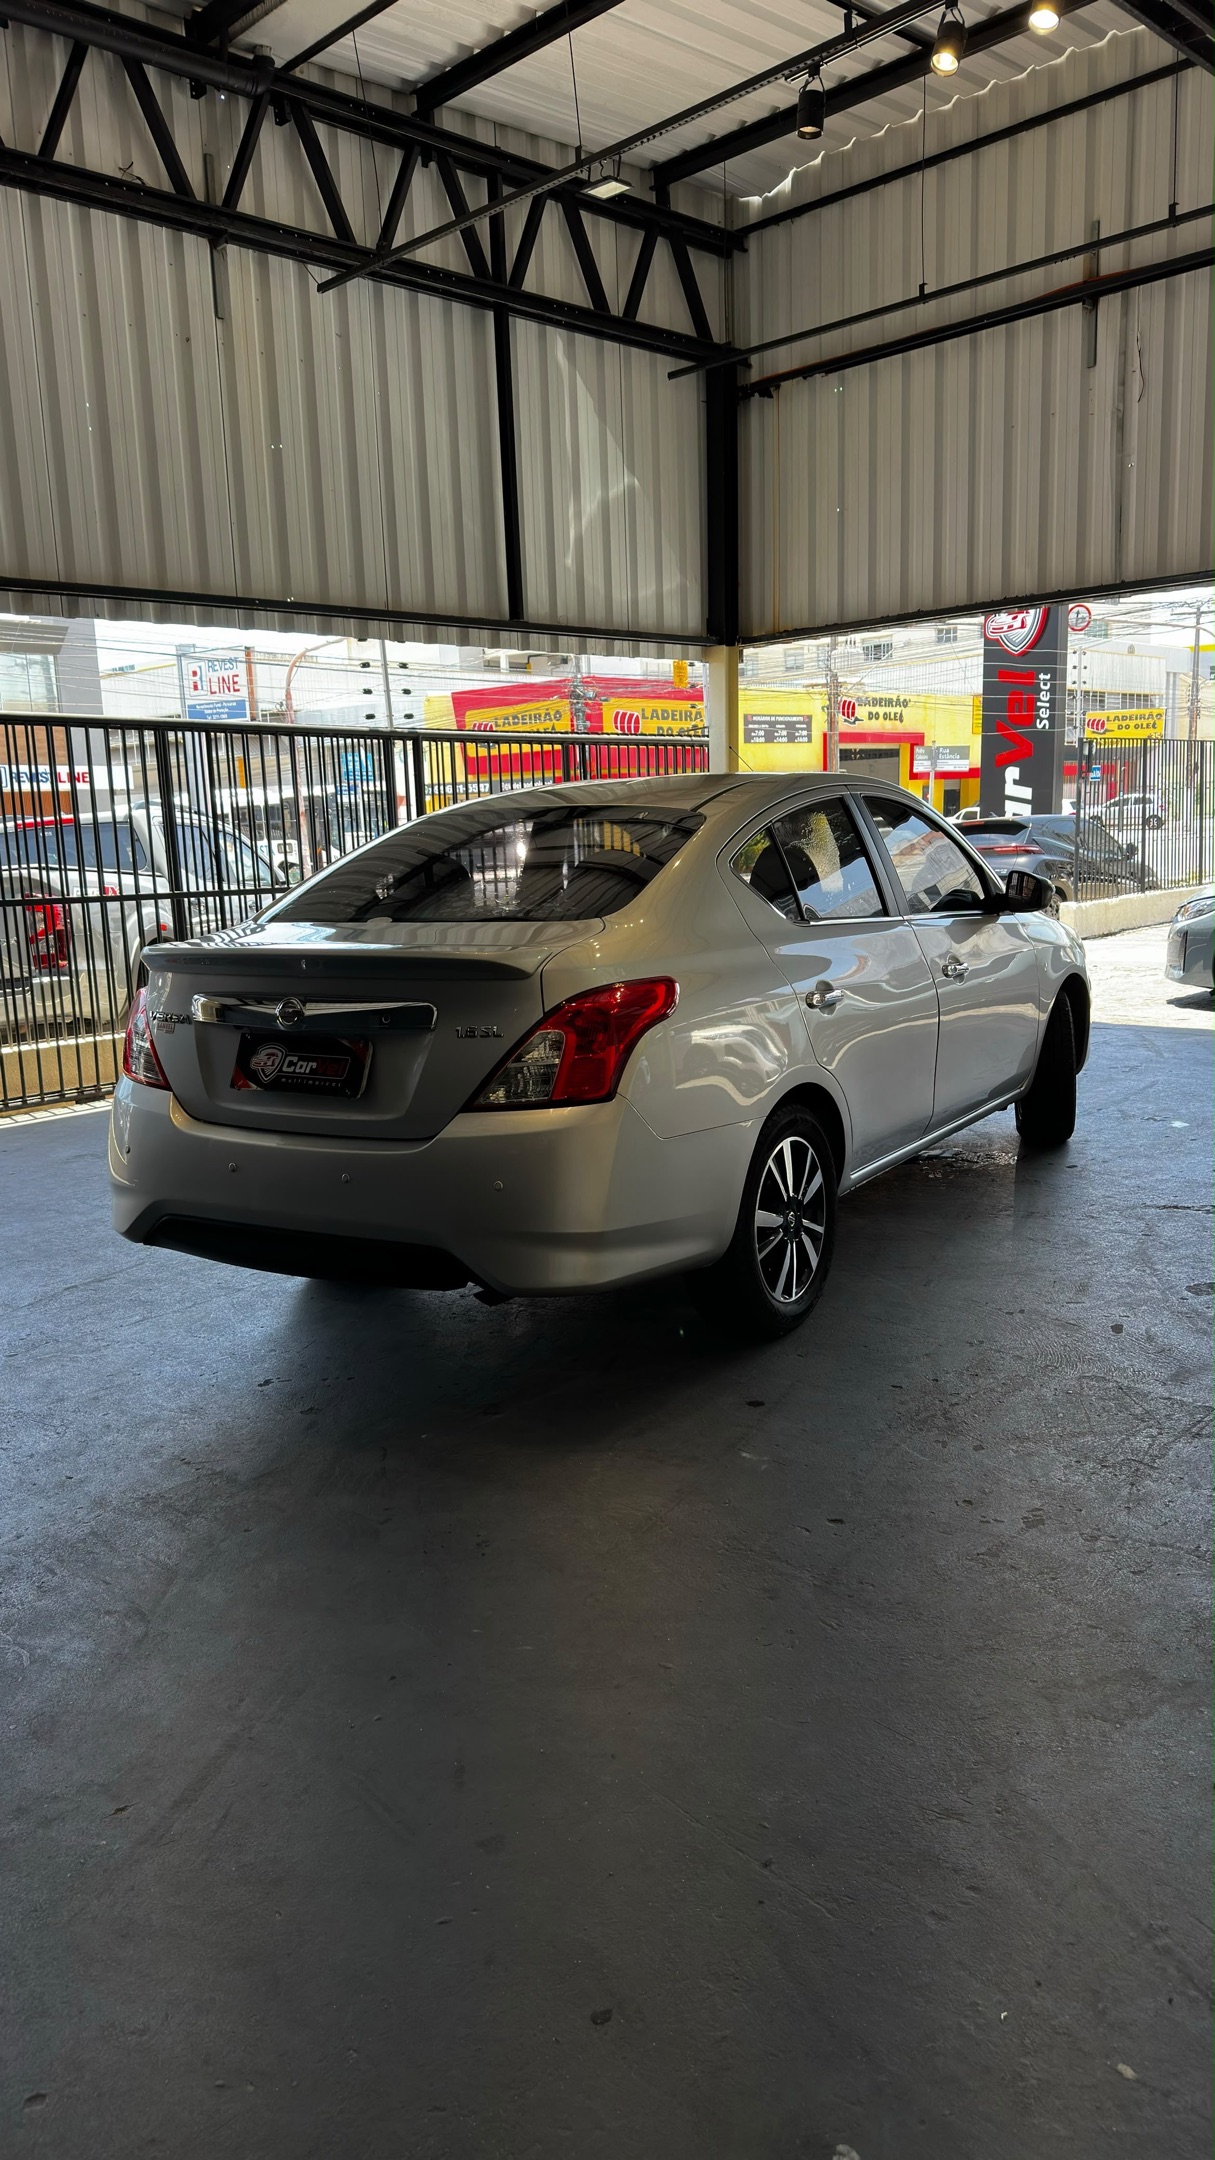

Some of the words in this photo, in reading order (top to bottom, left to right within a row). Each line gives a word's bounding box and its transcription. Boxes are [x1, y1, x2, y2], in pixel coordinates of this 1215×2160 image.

[207, 657, 239, 673] REVEST
[208, 674, 241, 695] LINE
[856, 694, 909, 708] LADEIRÃO
[1037, 673, 1051, 730] Select
[494, 708, 563, 728] LADEIRÃO
[868, 711, 880, 721] DO
[1106, 711, 1163, 722] LADEIRÃO
[57, 771, 90, 784] LINE
